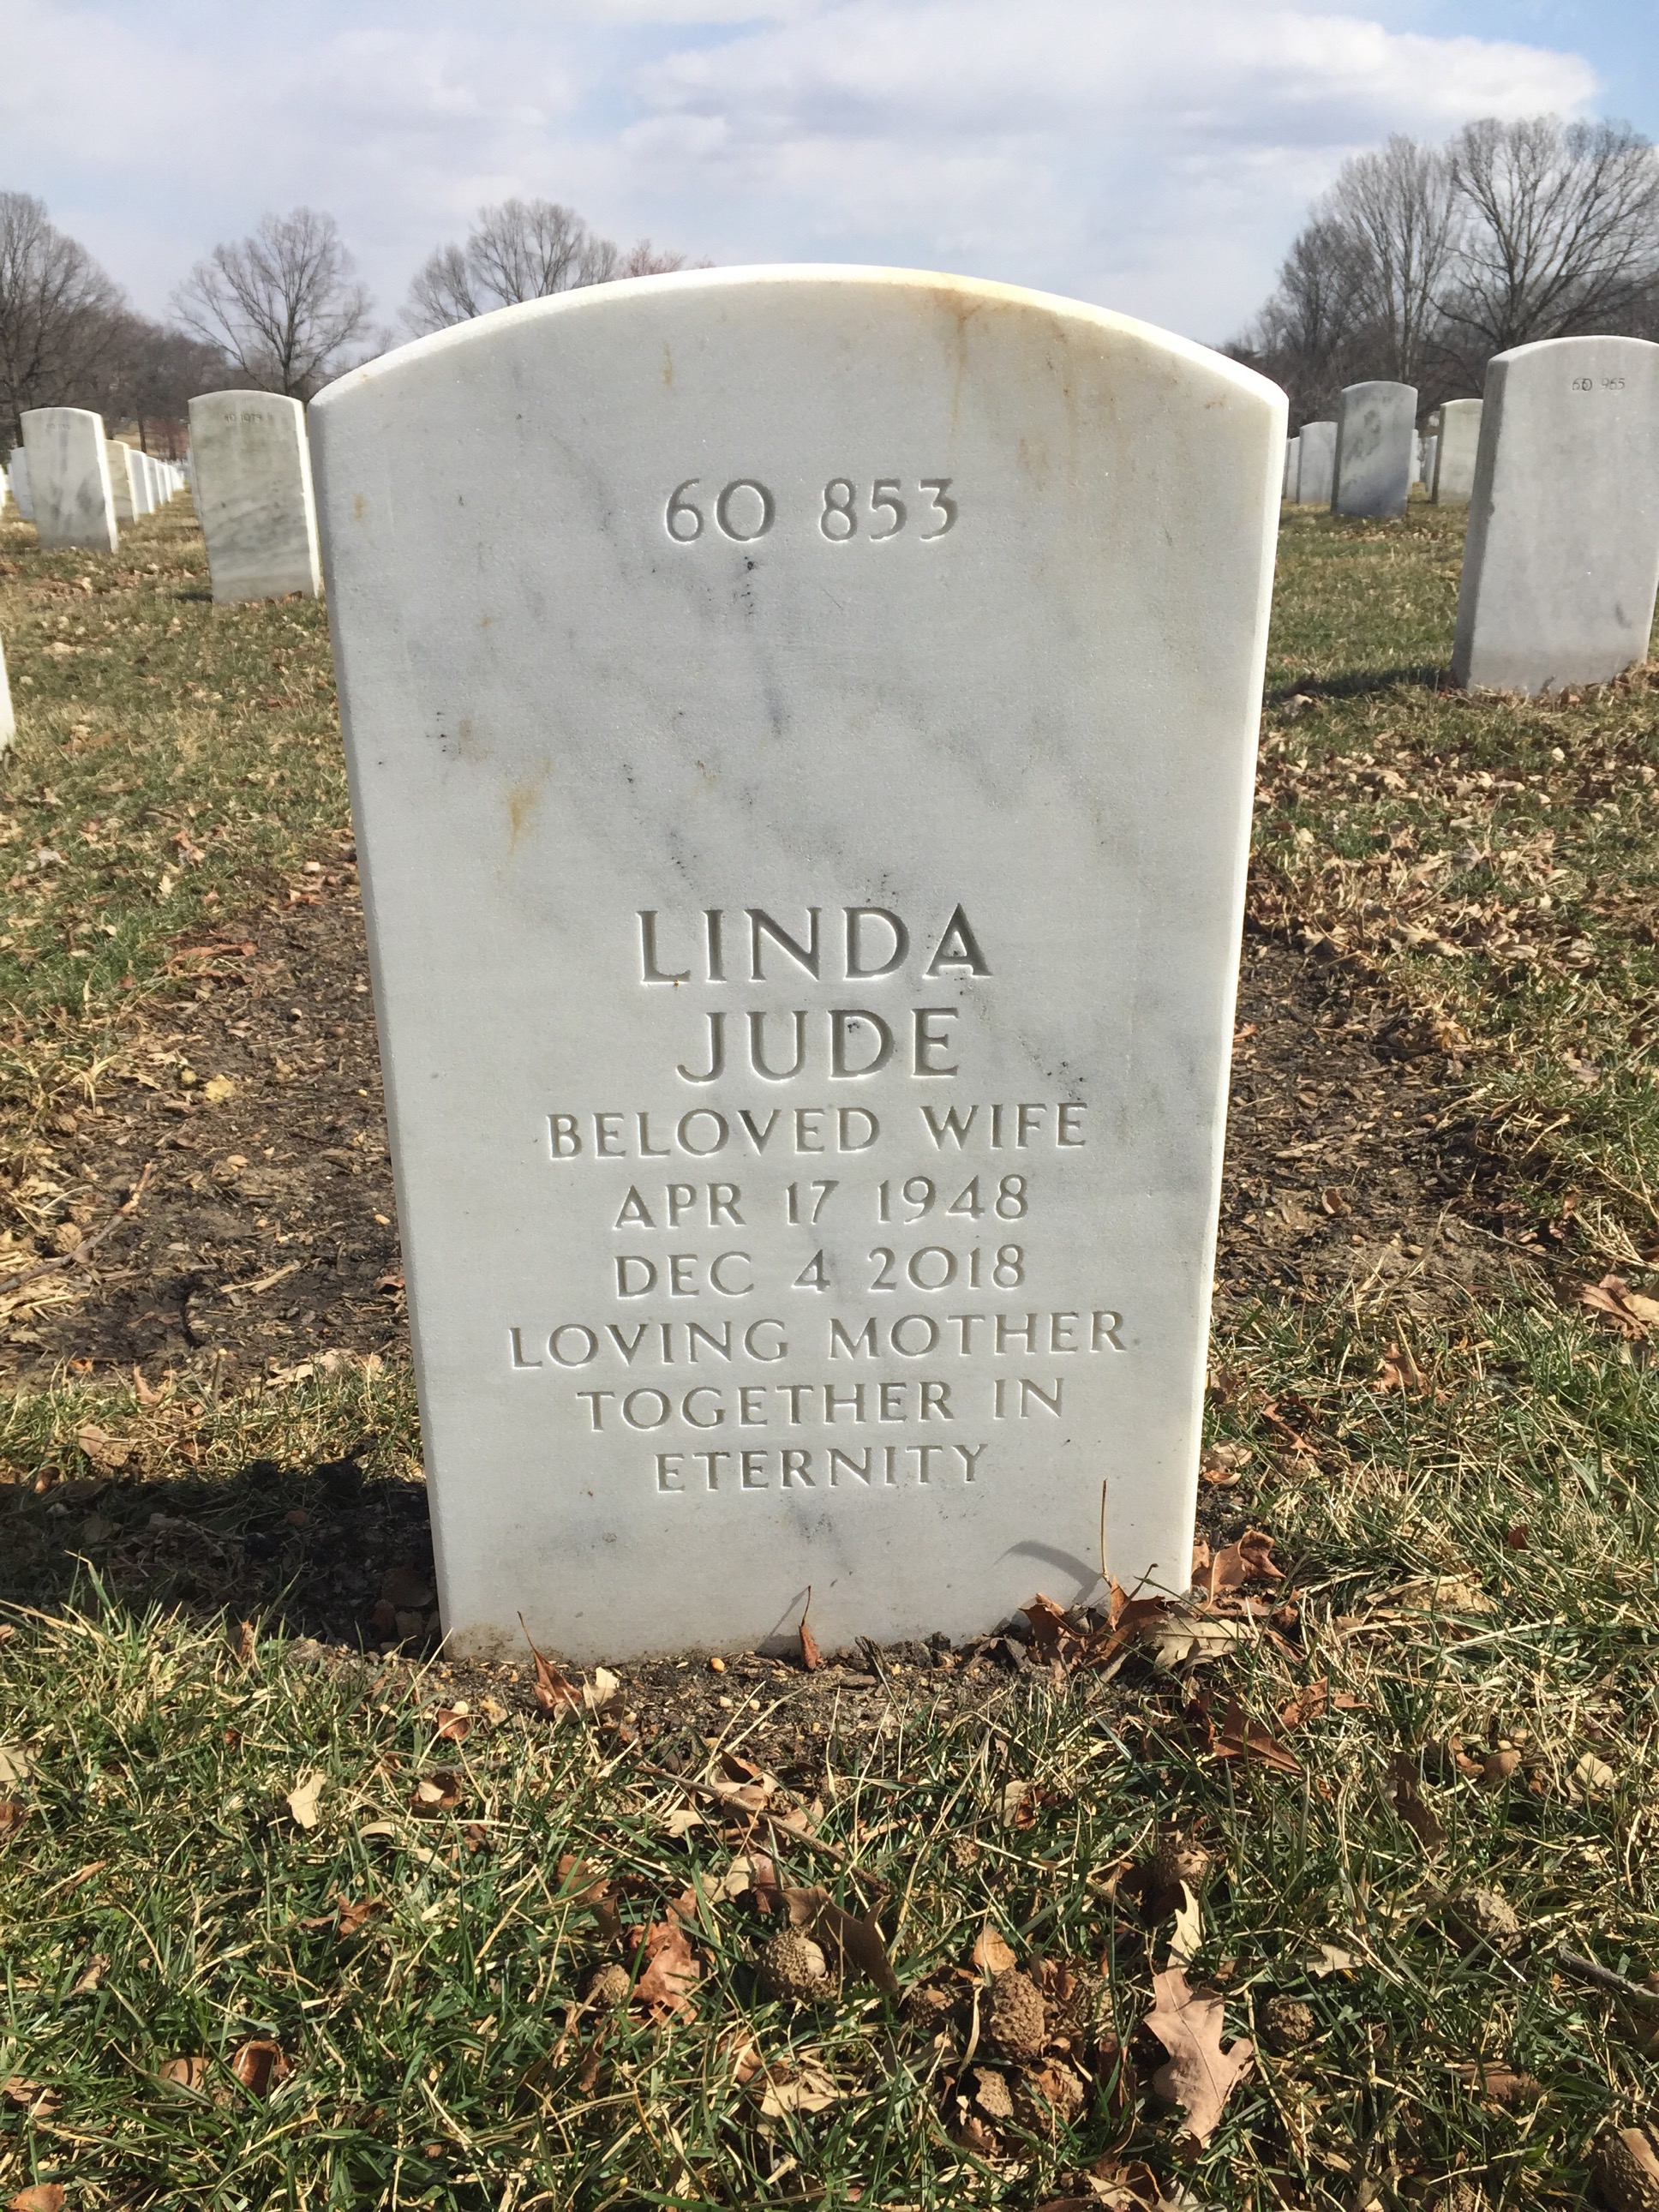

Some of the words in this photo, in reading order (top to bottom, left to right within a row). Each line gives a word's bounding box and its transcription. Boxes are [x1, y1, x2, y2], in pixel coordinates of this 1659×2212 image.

[1572, 377, 1593, 392] 60
[1601, 377, 1626, 391] 965
[665, 477, 776, 543] 60
[819, 477, 958, 543] 853
[637, 903, 992, 984] LINDA
[675, 1008, 959, 1086] JUDE
[545, 1107, 882, 1160] BELOVED
[921, 1102, 1088, 1150] WIFE
[612, 1183, 746, 1231] APR
[785, 1180, 840, 1226] 17
[877, 1173, 1030, 1224] 1948
[614, 1251, 755, 1300] DEC
[792, 1250, 831, 1292] 4
[867, 1244, 1027, 1292] 2018
[509, 1318, 789, 1370] LOVING
[828, 1310, 1128, 1360] MOTHER
[577, 1379, 955, 1431] TOGETHER
[992, 1377, 1064, 1419] IN
[655, 1443, 988, 1494] ETERNITY
